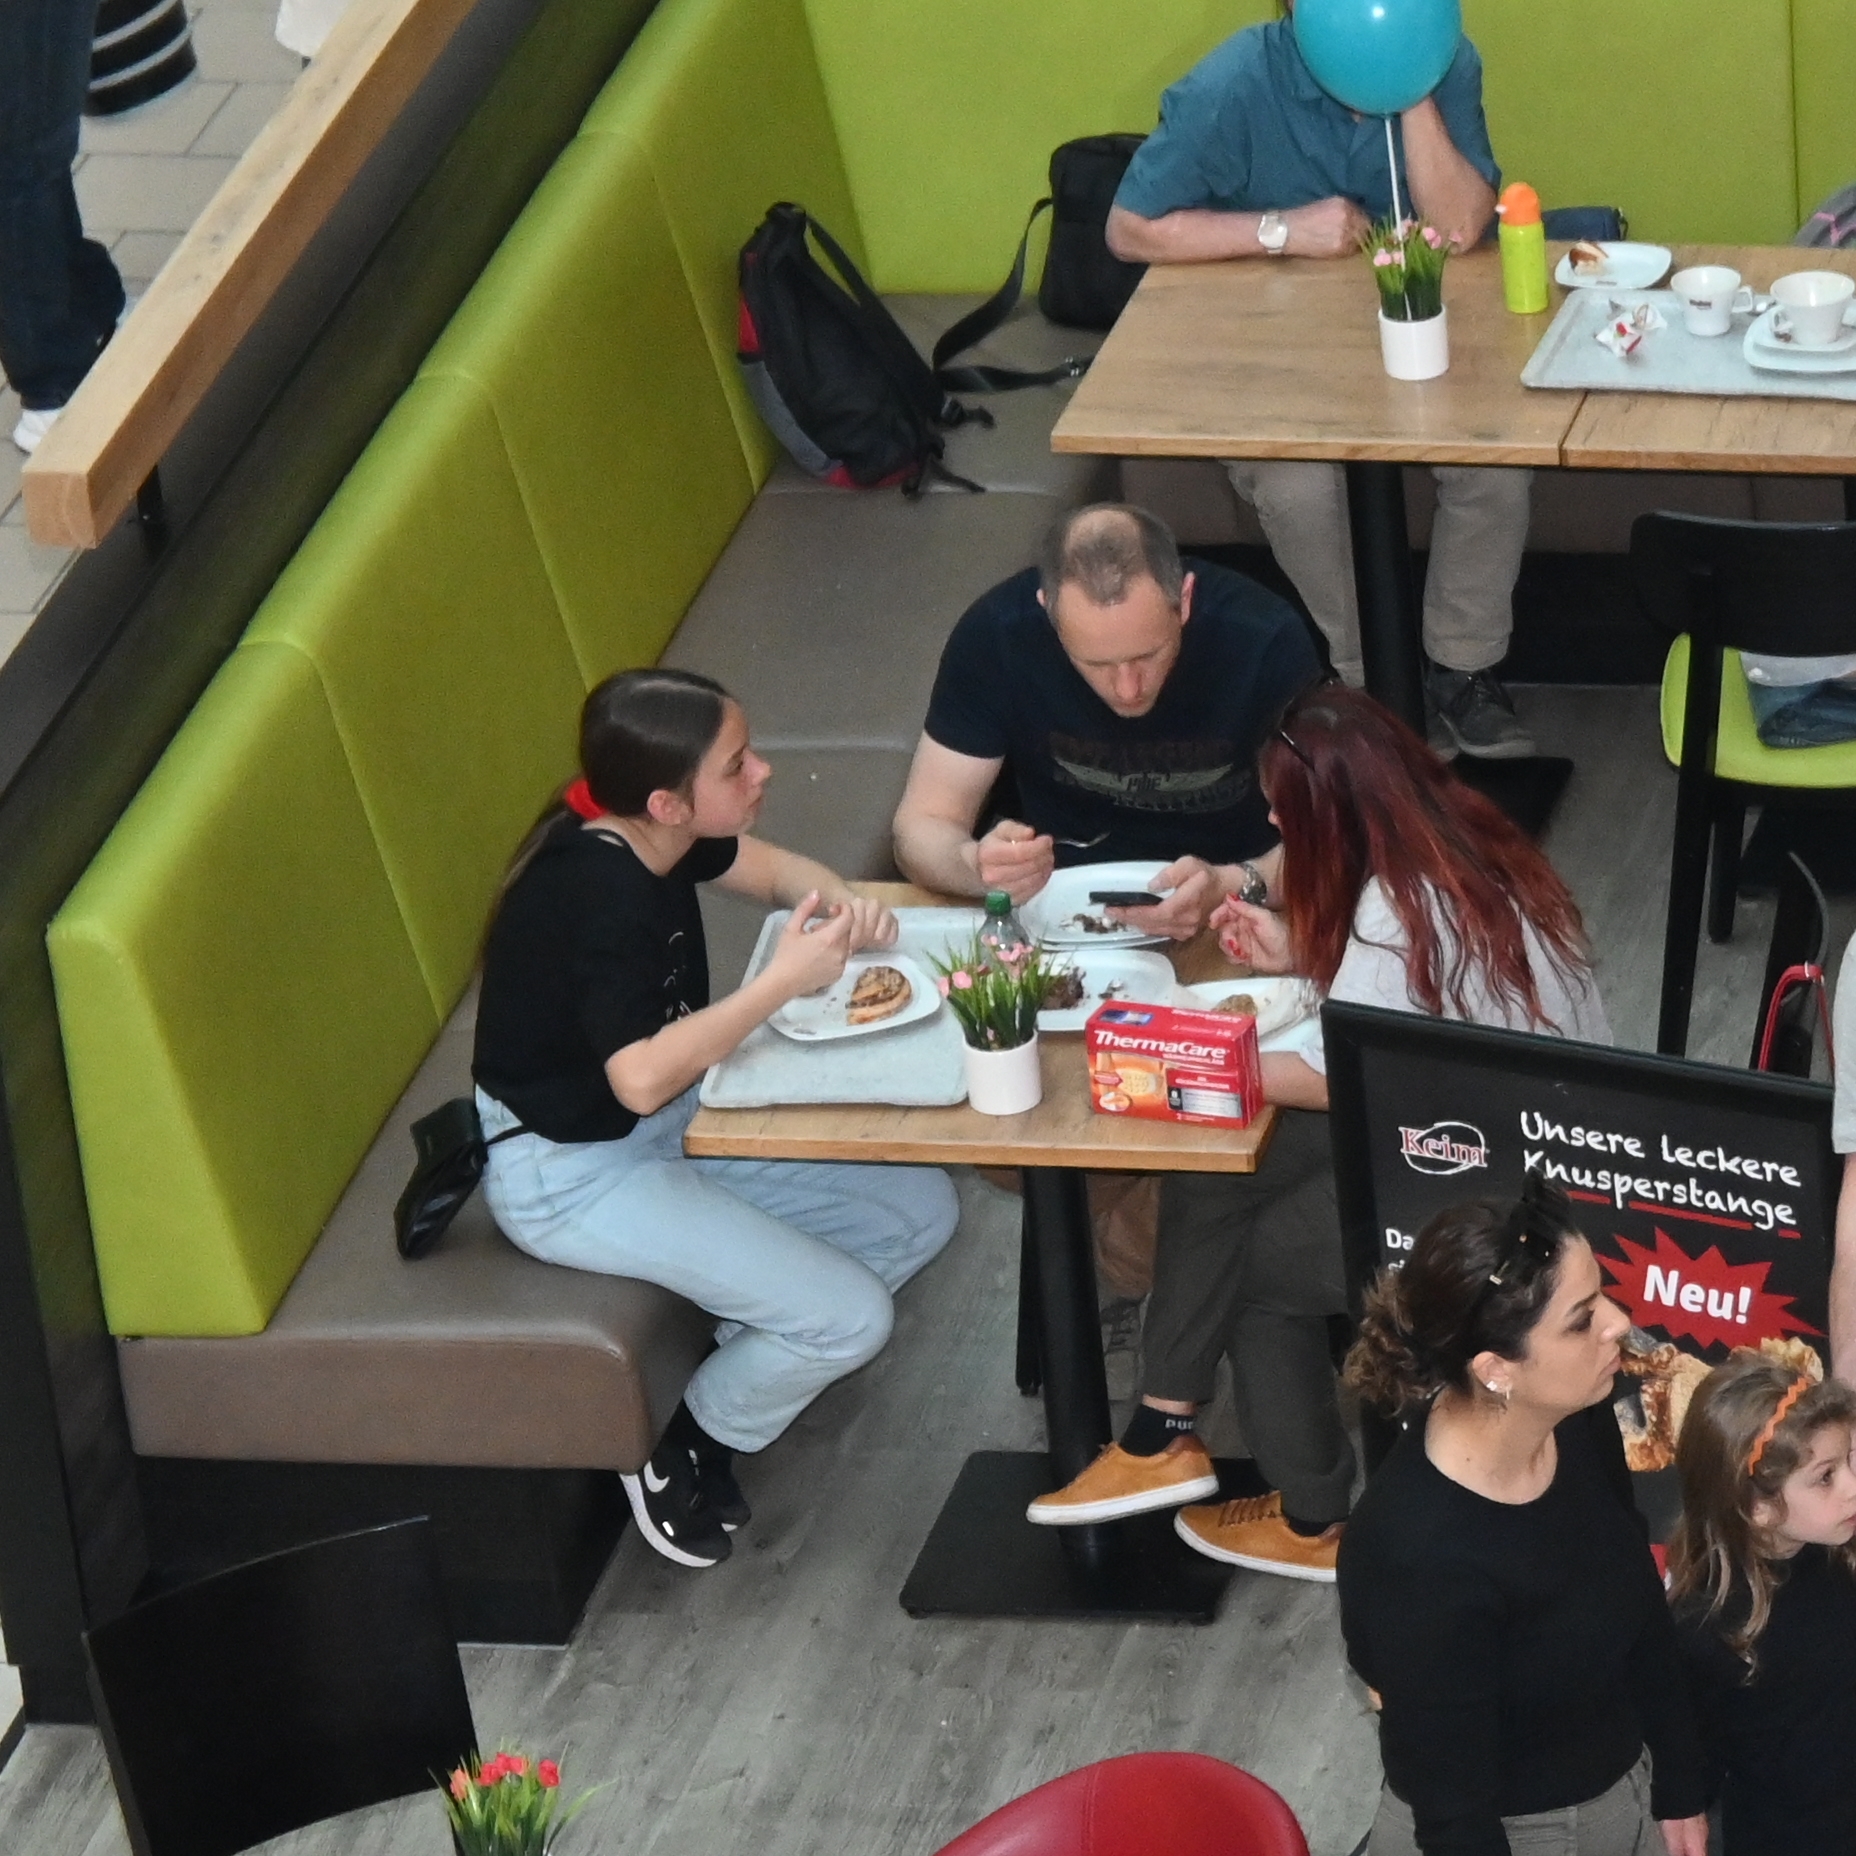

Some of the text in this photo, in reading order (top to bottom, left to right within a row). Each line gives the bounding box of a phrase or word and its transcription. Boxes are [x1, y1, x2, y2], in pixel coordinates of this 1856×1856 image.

[1095, 1030, 1225, 1058] ThermaCare
[1401, 1127, 1488, 1168] Keim
[1520, 1111, 1801, 1187] Unsere leckere
[1523, 1151, 1797, 1231] Knusperstange
[1386, 1228, 1414, 1250] Da
[1643, 1265, 1751, 1324] Neu!
